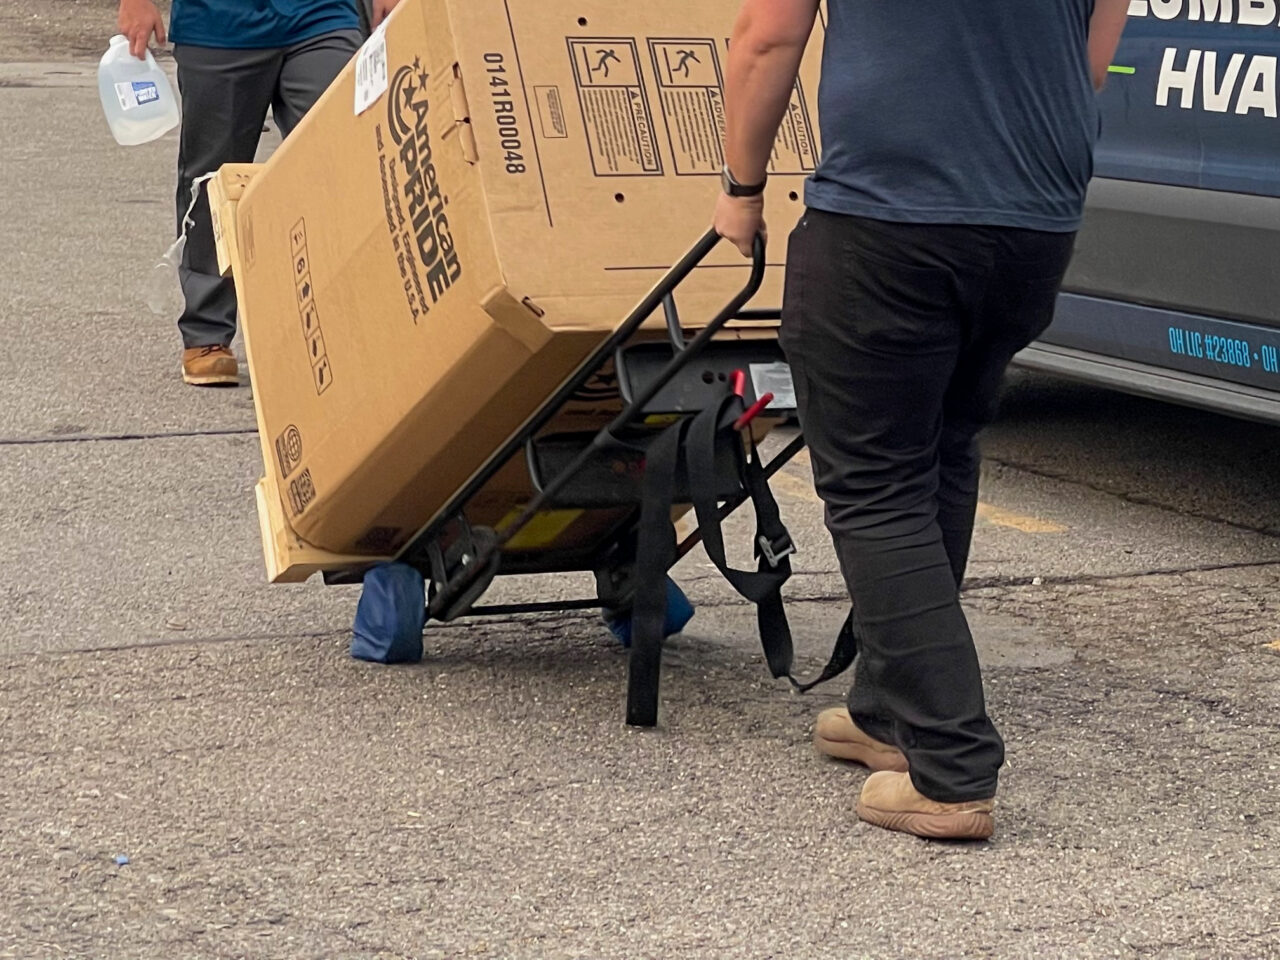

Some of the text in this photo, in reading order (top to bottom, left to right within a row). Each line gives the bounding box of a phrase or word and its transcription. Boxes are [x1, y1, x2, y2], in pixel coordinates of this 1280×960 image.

[483, 53, 526, 174] 0141R00048
[633, 101, 654, 166] PRECAUTION
[794, 112, 809, 156] CAUTION
[400, 133, 451, 305] PRIDE
[411, 99, 462, 285] American
[1168, 327, 1184, 354] OH
[1184, 329, 1203, 358] LIC
[1204, 334, 1251, 368] #23868
[1261, 344, 1278, 373] OH
